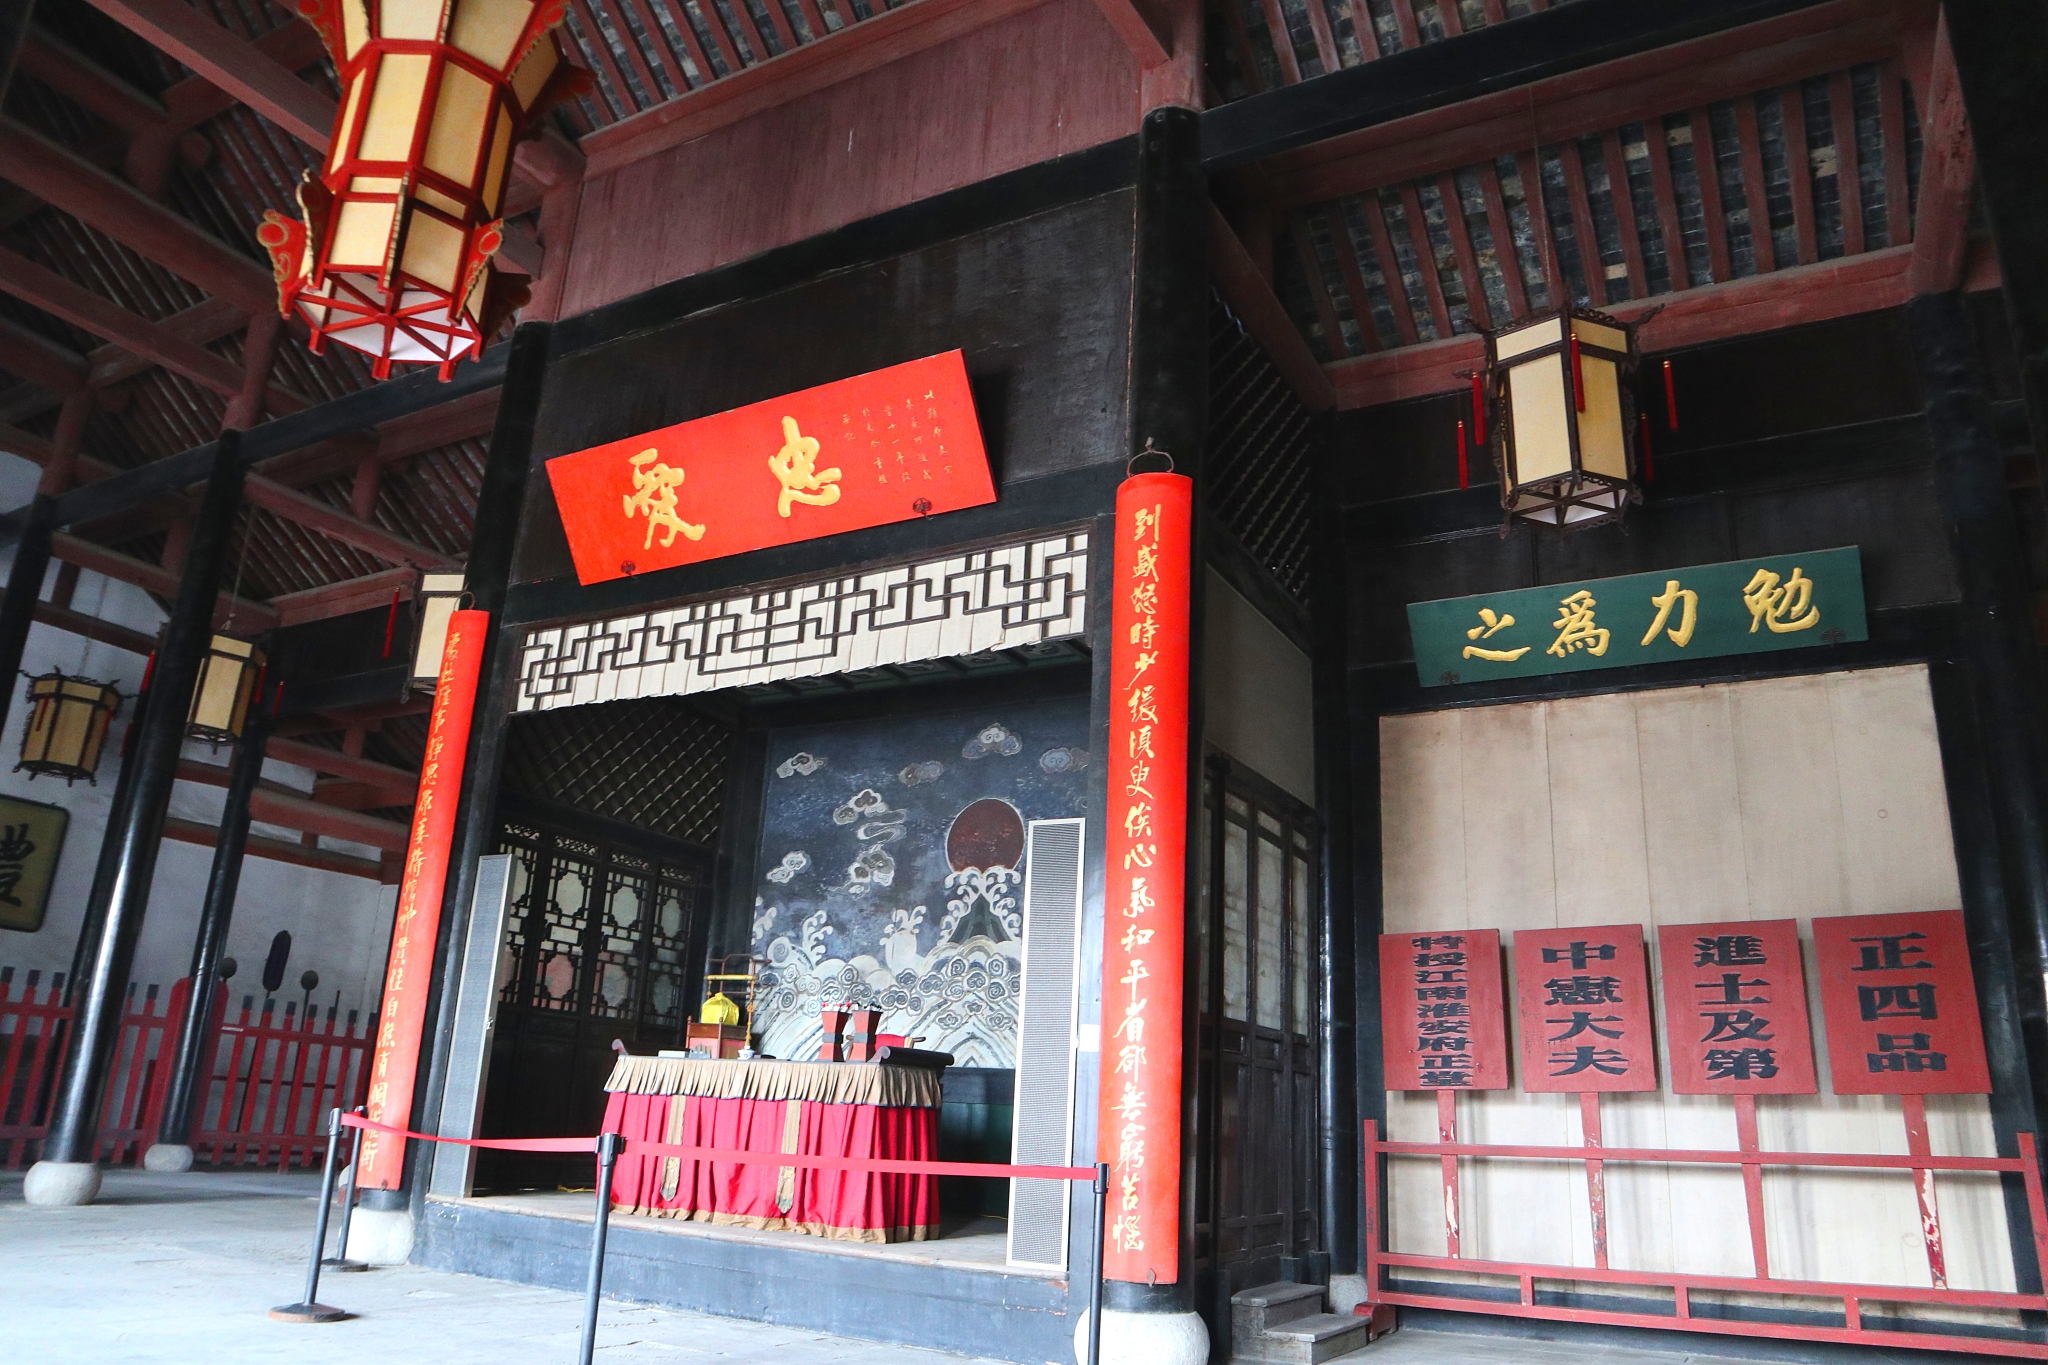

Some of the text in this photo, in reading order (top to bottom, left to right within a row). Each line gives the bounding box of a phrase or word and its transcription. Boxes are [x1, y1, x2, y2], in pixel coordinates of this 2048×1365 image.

[1412, 935, 1475, 1087] 特授江南淮安府正堂
[1541, 940, 1629, 1078] 中憲大夫
[1693, 934, 1780, 1081] 進士及第
[1851, 931, 1947, 1074] 正四品
